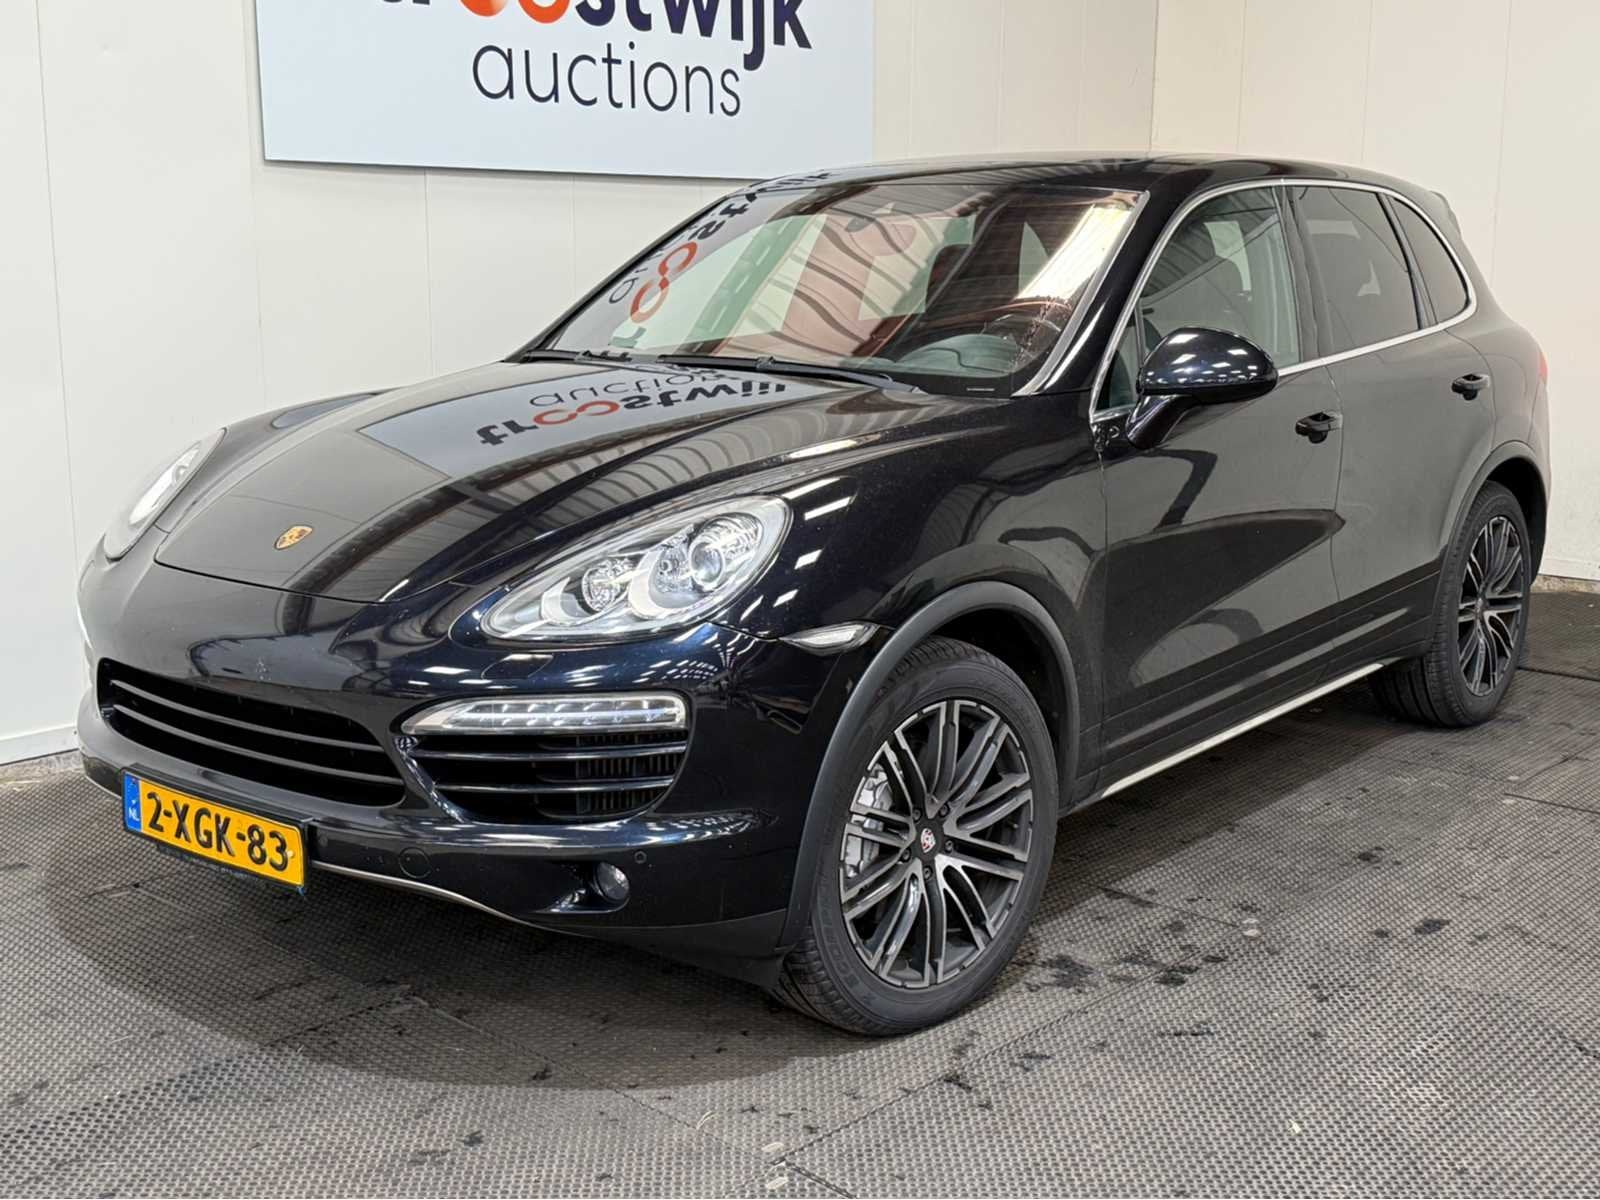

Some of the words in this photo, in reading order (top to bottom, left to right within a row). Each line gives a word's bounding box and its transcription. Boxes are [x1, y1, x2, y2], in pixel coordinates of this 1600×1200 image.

[382, 0, 812, 71] stwijk
[472, 41, 741, 117] auctions
[128, 807, 141, 822] NL
[146, 791, 289, 872] 2-XGK-83
